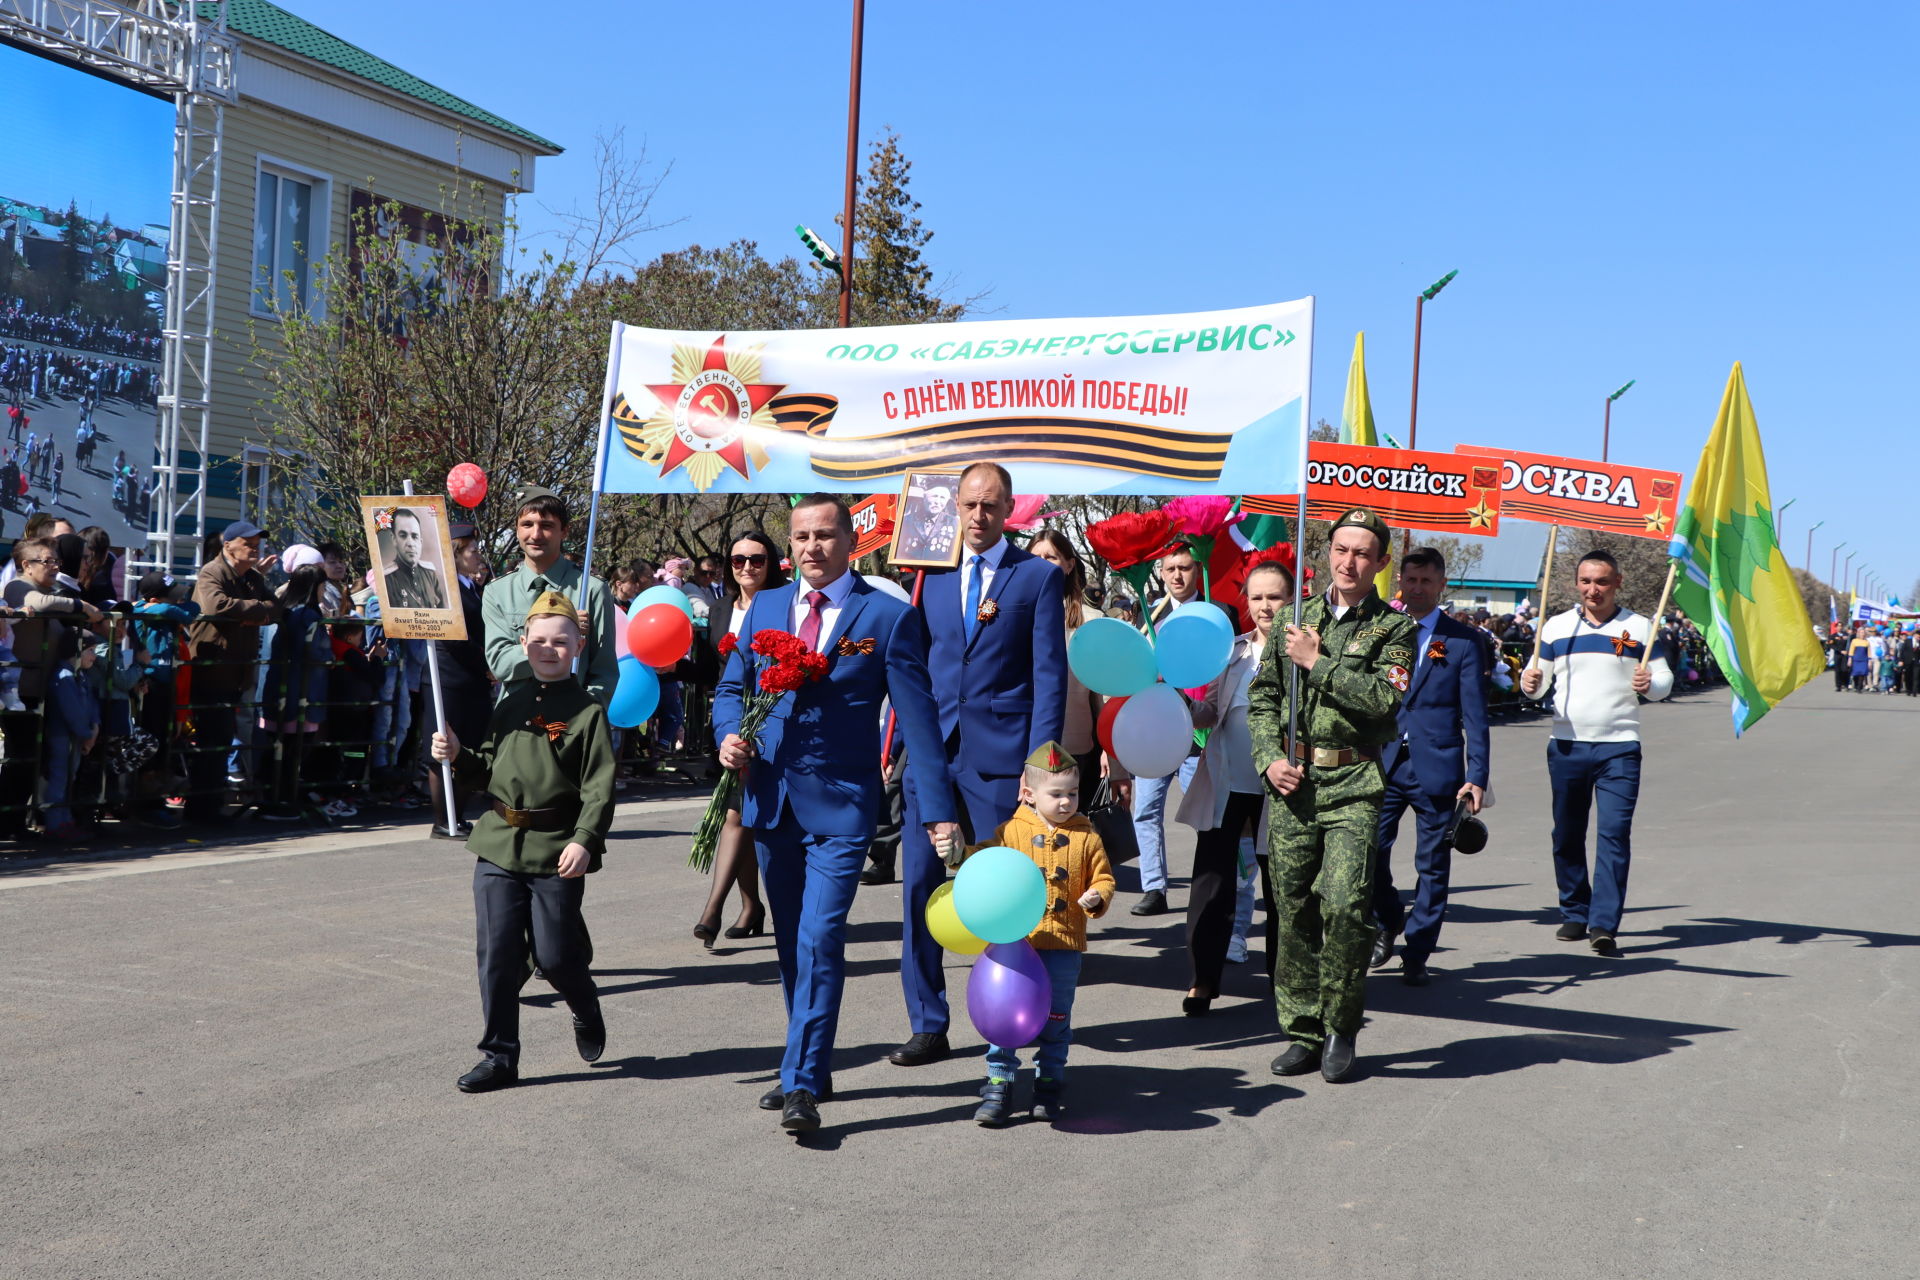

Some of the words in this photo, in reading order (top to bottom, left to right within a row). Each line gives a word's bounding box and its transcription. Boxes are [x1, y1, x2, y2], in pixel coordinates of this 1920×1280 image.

[825, 343, 899, 362] ООО
[910, 323, 1296, 362] «САБЭНЕРГОСЕРВИС»
[676, 372, 744, 444] ОТЕЕСТВЕННАЯ
[883, 391, 898, 420] С
[903, 378, 967, 420] ДНЁМ
[971, 373, 1075, 409] ВЕЛИКОЙ
[1082, 379, 1189, 417] ПОБЕДЫ!
[1307, 461, 1465, 498] ОРОССИЙСК
[1502, 459, 1640, 509] ОСКВА
[850, 502, 877, 535] РЧЬ
